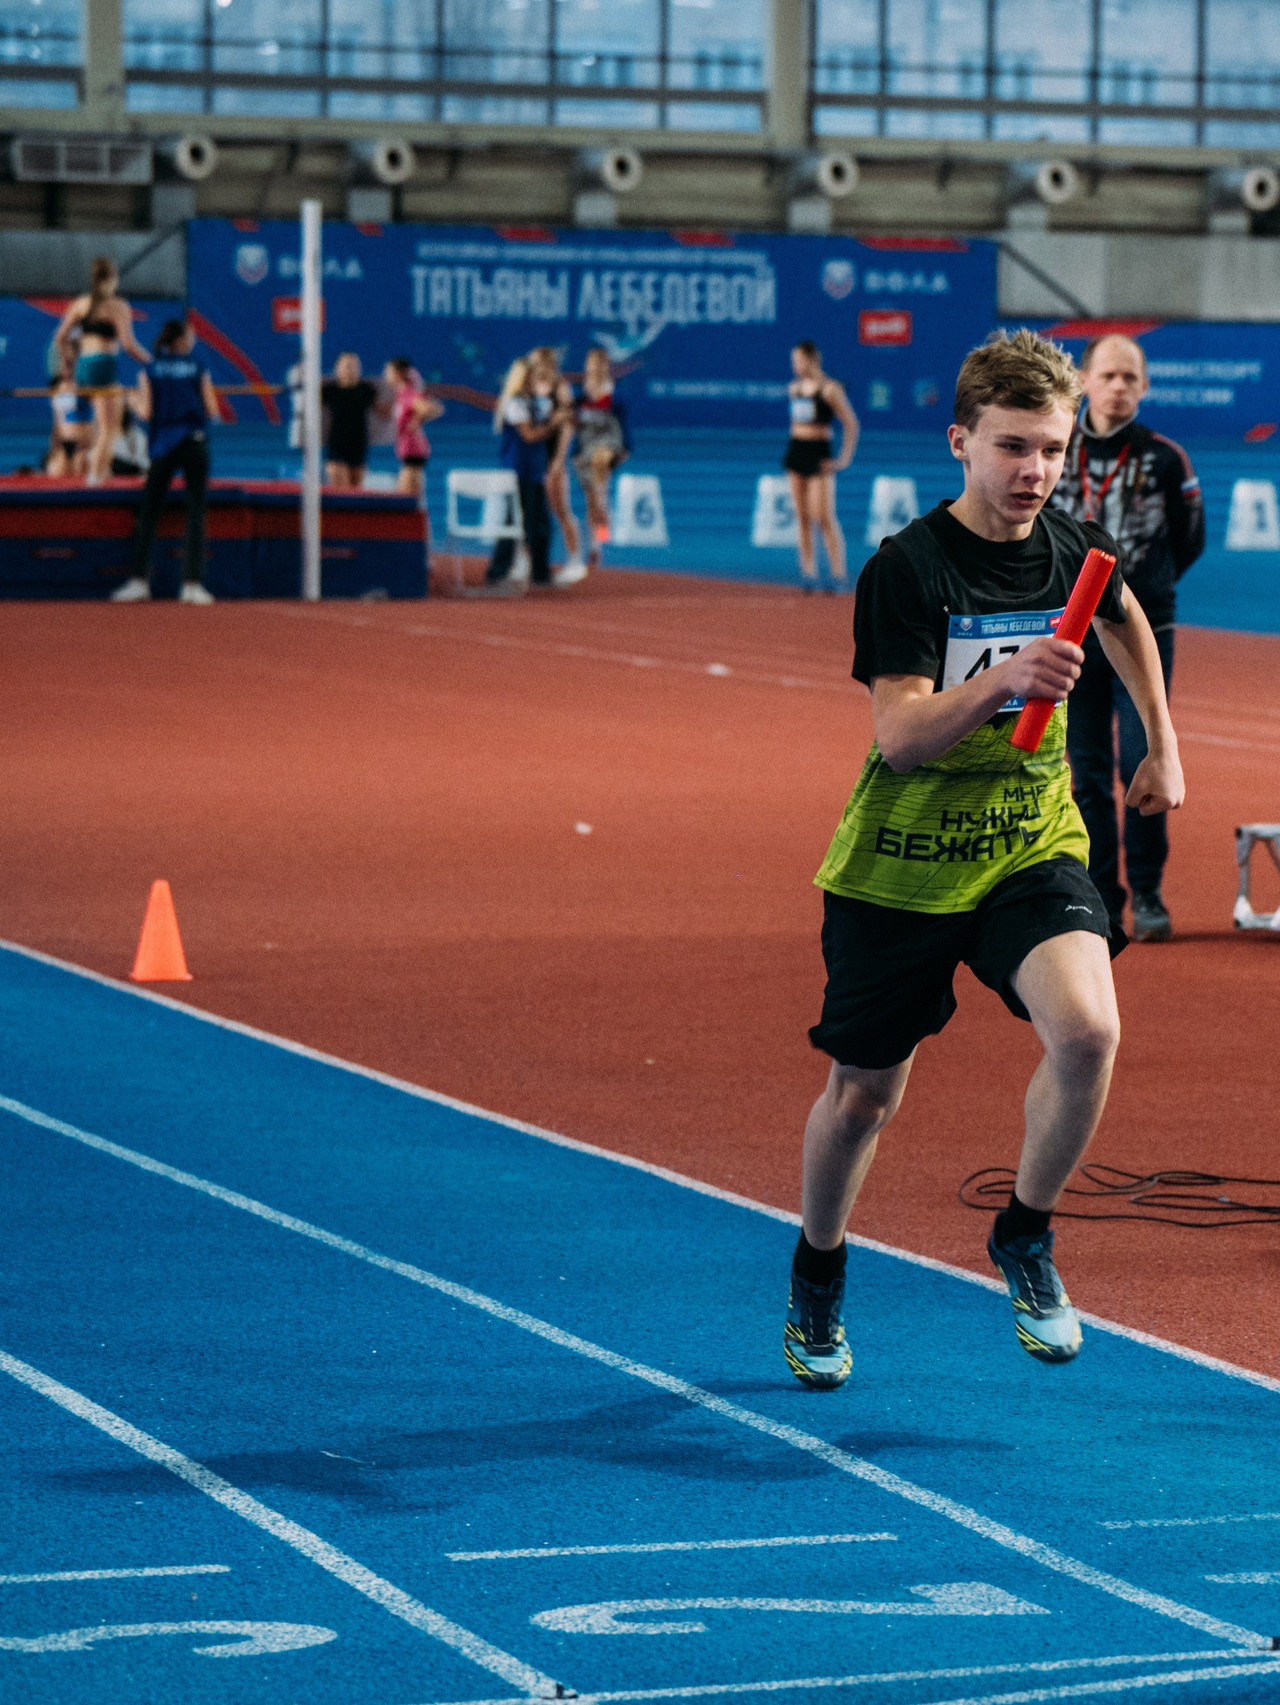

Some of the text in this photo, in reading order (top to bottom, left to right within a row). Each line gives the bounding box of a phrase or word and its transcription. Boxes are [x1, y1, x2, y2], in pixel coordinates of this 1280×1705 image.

[411, 262, 777, 326] ТАТЬЯНЫ ЛЕБЕДЕВОЙ
[981, 624, 1008, 635] ТАТЬЯНЫ
[1009, 619, 1046, 632] ЛЕБЕДЕВОЙ
